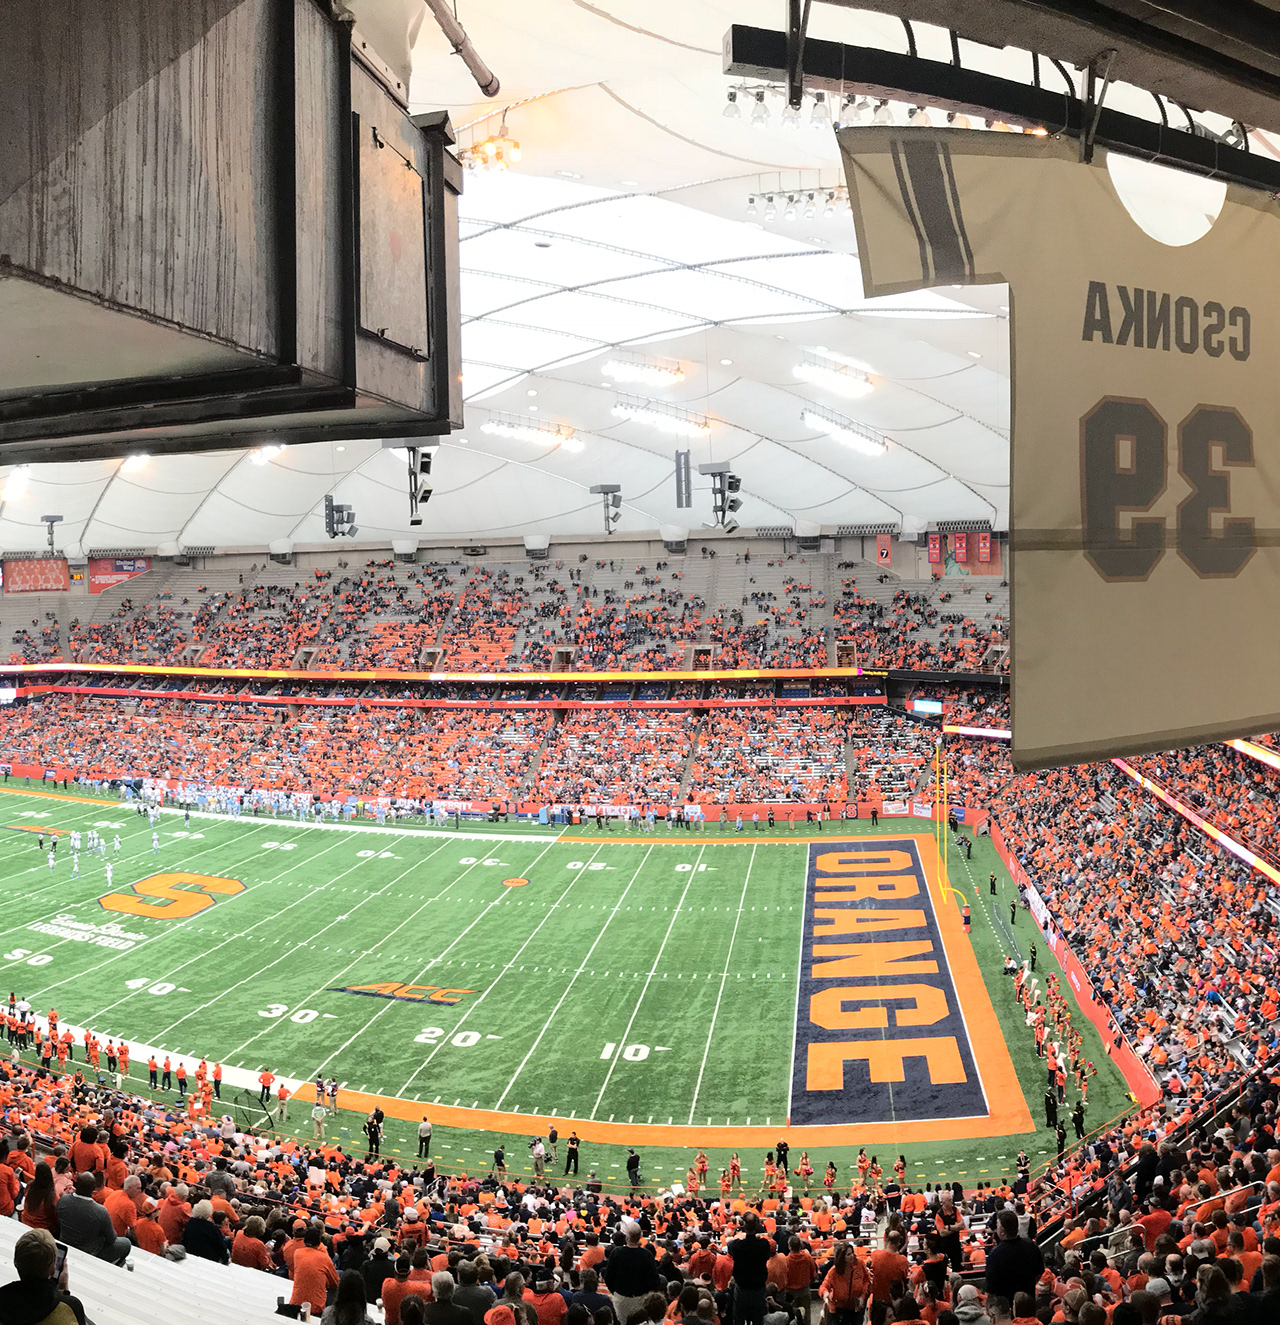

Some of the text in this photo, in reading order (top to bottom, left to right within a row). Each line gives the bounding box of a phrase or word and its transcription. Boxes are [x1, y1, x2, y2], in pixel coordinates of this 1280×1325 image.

[881, 550, 887, 558] 7
[846, 803, 857, 819] S
[355, 849, 395, 860] 40
[566, 861, 607, 871] 20
[674, 863, 708, 872] 10
[98, 871, 249, 920] S
[87, 935, 136, 950] FIELD
[3, 948, 54, 965] 50
[806, 849, 968, 1091] ORANGE
[125, 977, 176, 995] 40
[345, 981, 478, 1004] ACC
[257, 1003, 320, 1023] 30
[413, 1026, 482, 1047] 20
[600, 1043, 650, 1061] 10
